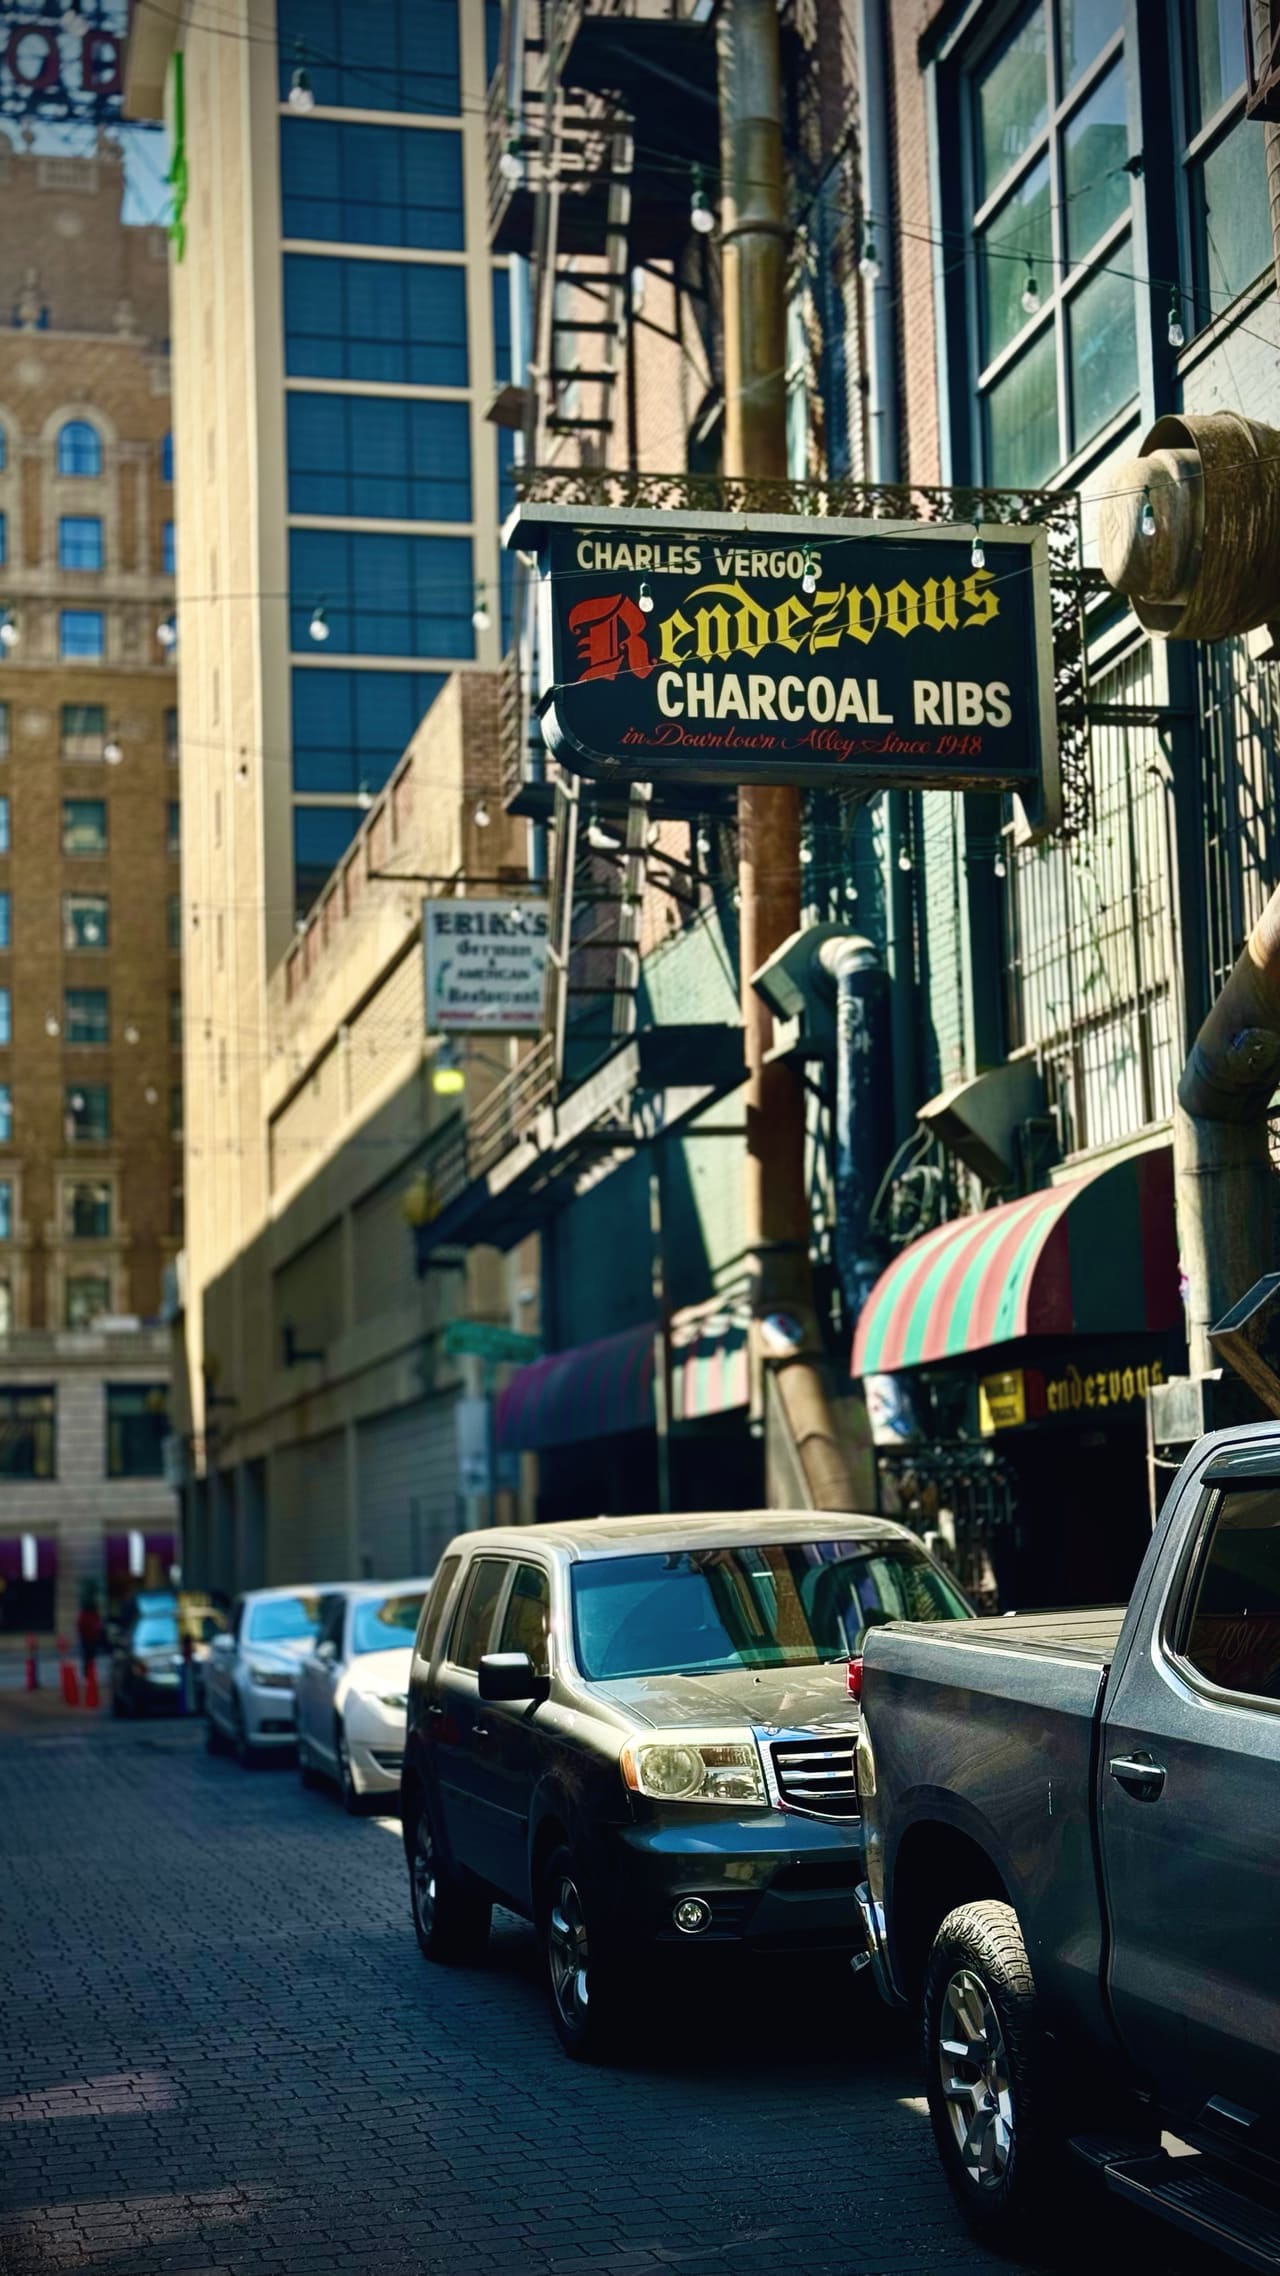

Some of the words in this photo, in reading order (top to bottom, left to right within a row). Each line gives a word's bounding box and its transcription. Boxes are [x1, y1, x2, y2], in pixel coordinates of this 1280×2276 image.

[576, 539, 702, 576] CHARLES
[568, 566, 1000, 681] Rendezvous
[656, 670, 894, 725] CHARCOAL
[912, 679, 1012, 728] RIBS
[620, 725, 646, 745] in
[646, 721, 777, 749] Downtown
[780, 728, 857, 763] Alley
[857, 730, 931, 754] Since
[934, 735, 982, 756] 1948
